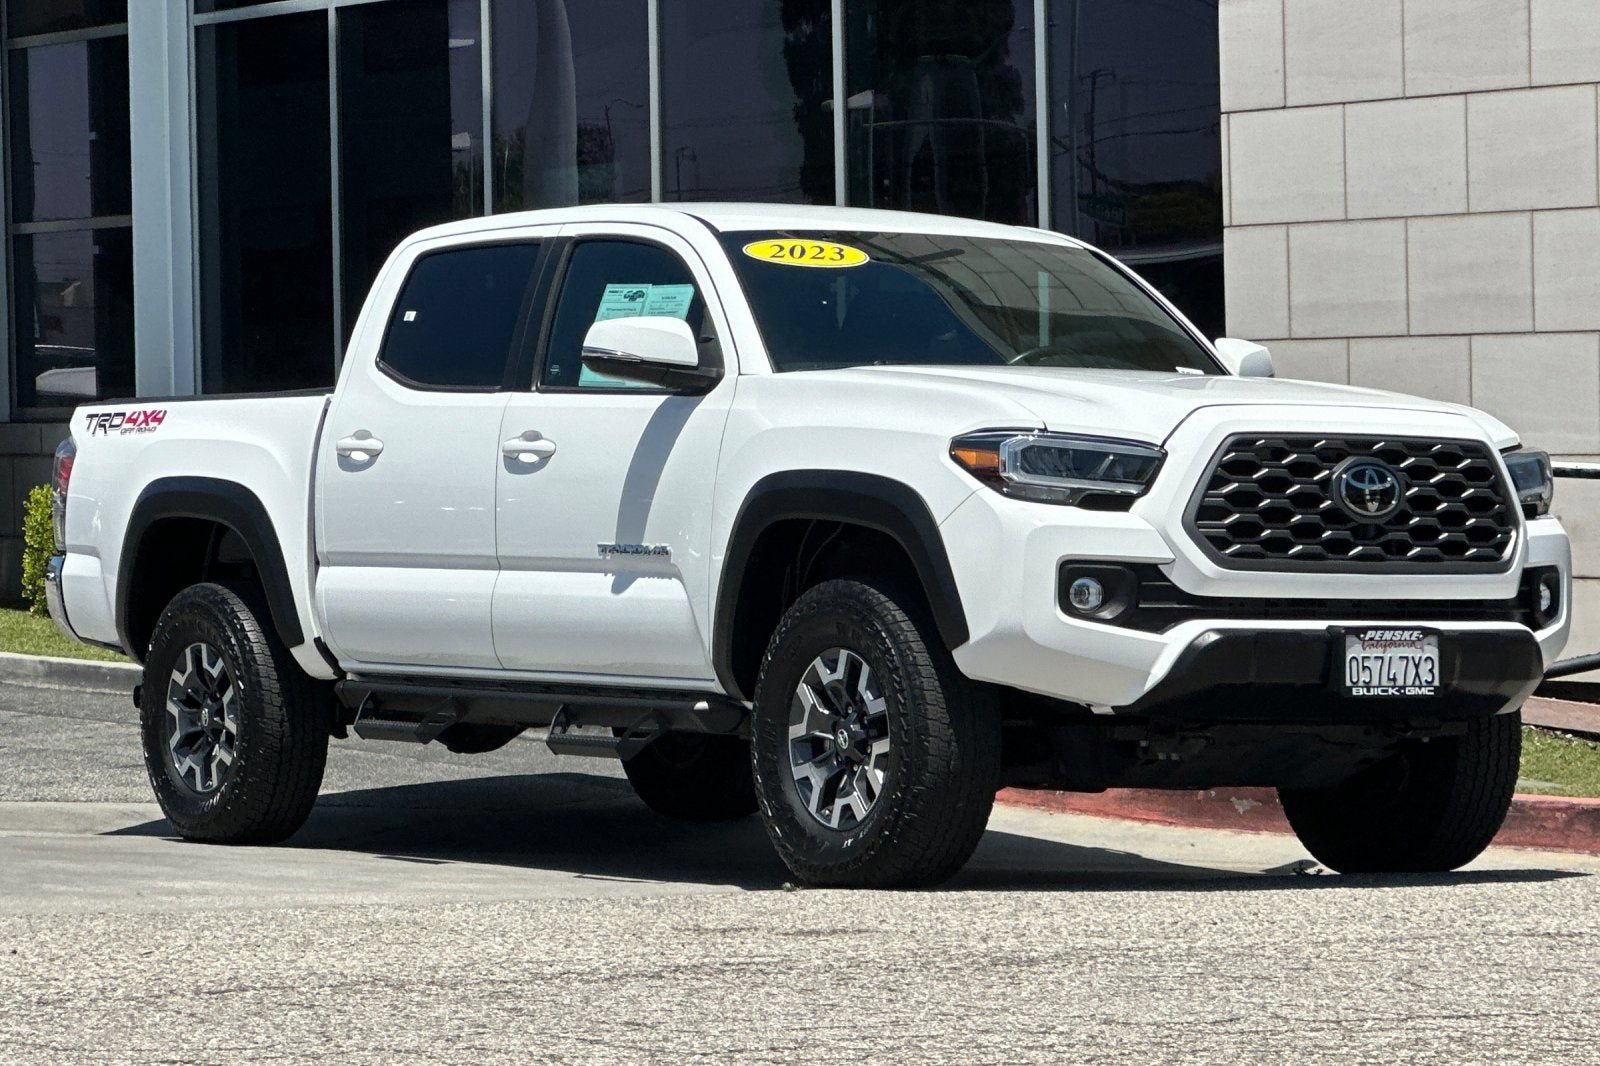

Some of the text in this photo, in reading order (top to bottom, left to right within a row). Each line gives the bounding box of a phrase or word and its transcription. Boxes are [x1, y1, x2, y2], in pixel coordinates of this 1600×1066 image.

[769, 243, 845, 262] 2023
[86, 412, 126, 436] TRD
[120, 427, 135, 435] OFF
[1365, 630, 1421, 641] PENSKE
[1349, 655, 1435, 685] 05747X3
